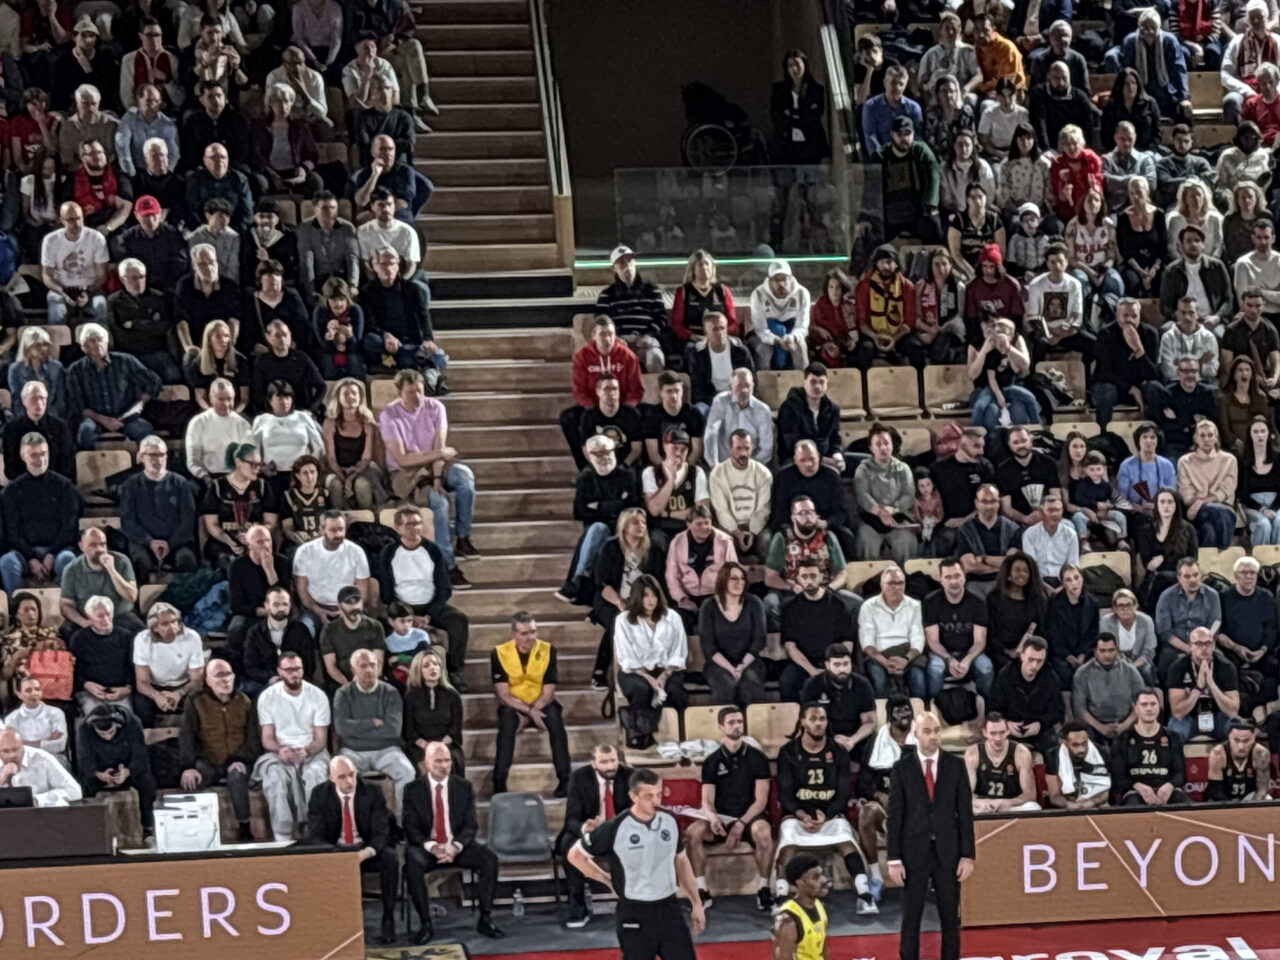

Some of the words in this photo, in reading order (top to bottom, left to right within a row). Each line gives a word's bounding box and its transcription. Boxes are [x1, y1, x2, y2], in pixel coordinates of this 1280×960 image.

[1142, 750, 1157, 765] 26
[807, 768, 824, 785] 23
[987, 781, 1004, 797] 22
[0, 882, 292, 948] RDERS
